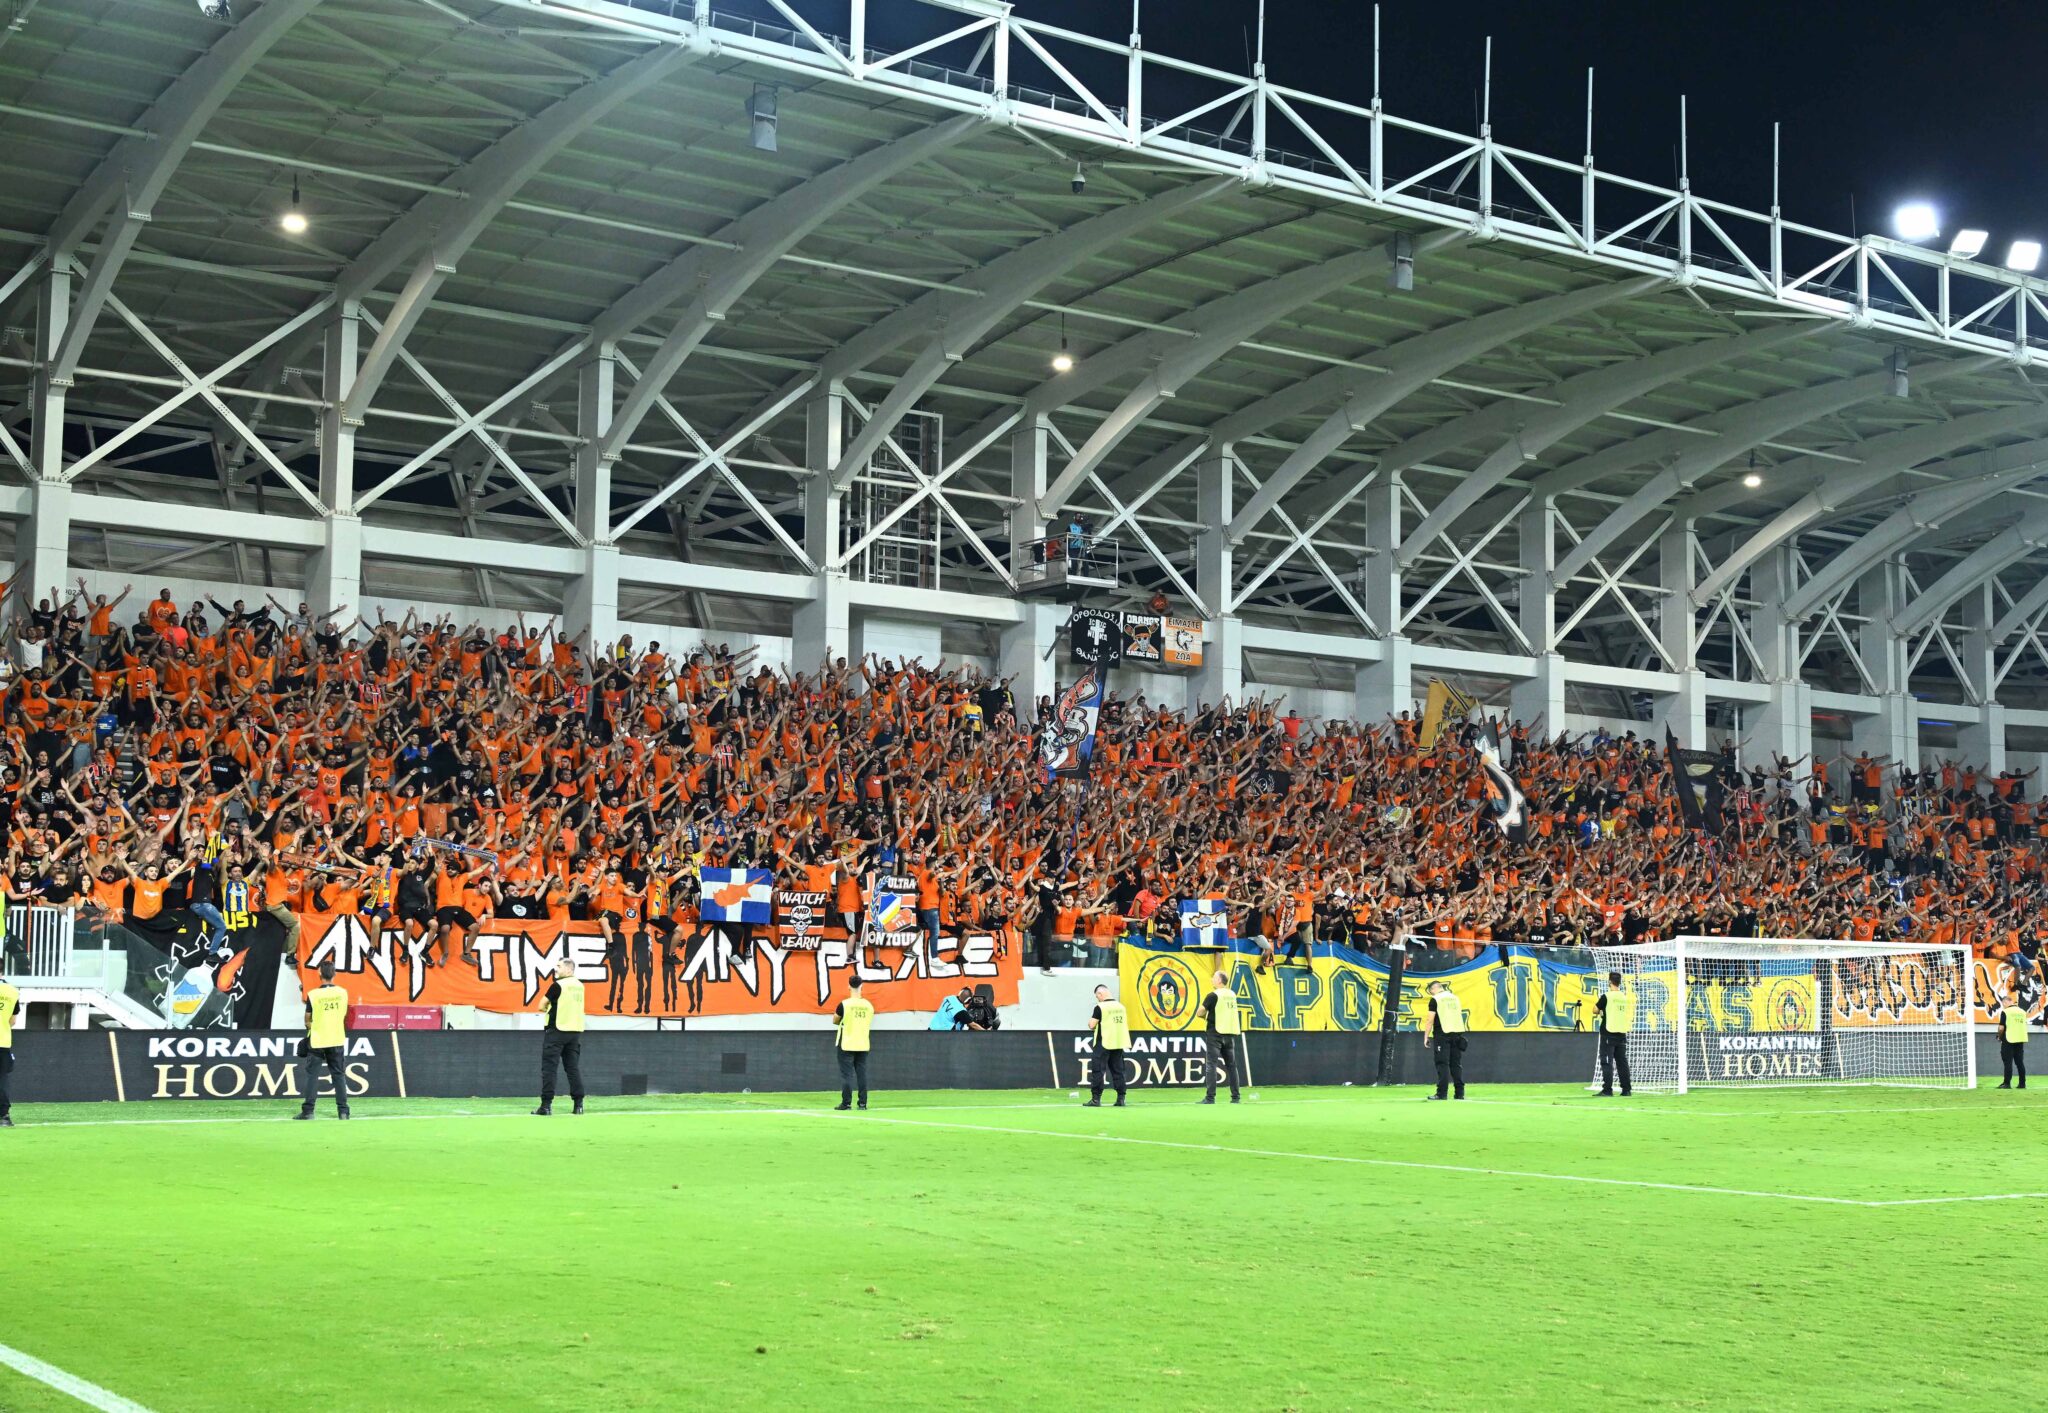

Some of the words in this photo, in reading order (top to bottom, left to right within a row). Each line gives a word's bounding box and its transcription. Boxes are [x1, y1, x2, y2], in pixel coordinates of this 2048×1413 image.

[1168, 617, 1201, 629] ΕΙΜΑΣΤΕ
[1175, 652, 1192, 662] ΖΩΑ
[779, 891, 826, 905] WATCH
[793, 907, 809, 915] AND
[781, 935, 822, 950] LEARN
[304, 913, 439, 1002] ANY
[464, 930, 609, 1006] TIME
[679, 926, 796, 1005] ANY
[816, 931, 999, 1006] PLACE
[324, 1002, 339, 1010] 241
[942, 998, 954, 1012] TV
[148, 1037, 376, 1058] KORANTA
